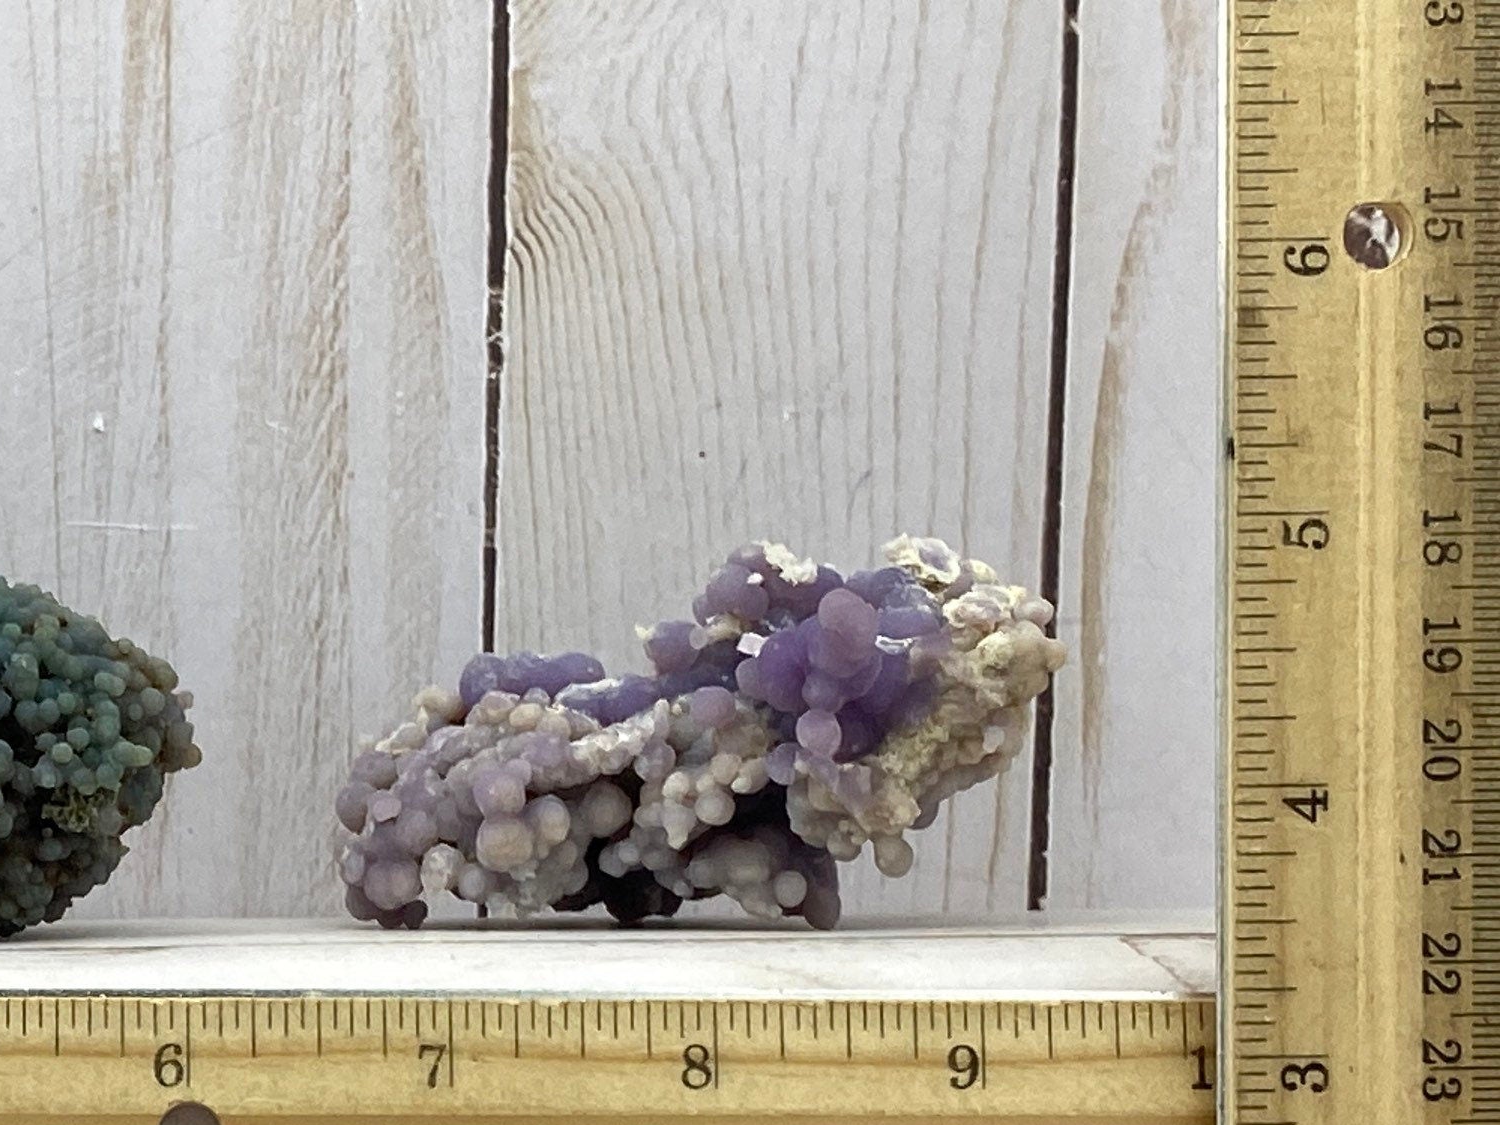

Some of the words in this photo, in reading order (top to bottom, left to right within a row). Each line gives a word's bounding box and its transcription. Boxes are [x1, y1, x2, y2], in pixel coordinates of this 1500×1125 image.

[1422, 0, 1464, 27] 3
[1422, 78, 1464, 136] 14
[1422, 188, 1464, 242] 15
[1284, 243, 1330, 277] 6
[1422, 295, 1464, 350] 16
[1422, 402, 1464, 459] 17
[1284, 518, 1330, 551] 5
[1422, 509, 1464, 566] 18
[1422, 617, 1464, 673] 19
[1422, 717, 1464, 782] 20
[1284, 789, 1330, 823] 4
[1422, 830, 1464, 884] 21
[1422, 931, 1464, 997] 22
[153, 1042, 184, 1087] 6
[418, 1045, 447, 1088] 7
[681, 1045, 713, 1088] 8
[947, 1045, 980, 1088] 9
[1190, 1046, 1214, 1089] 1
[1282, 1060, 1329, 1094] 3
[1422, 1039, 1464, 1101] 23
